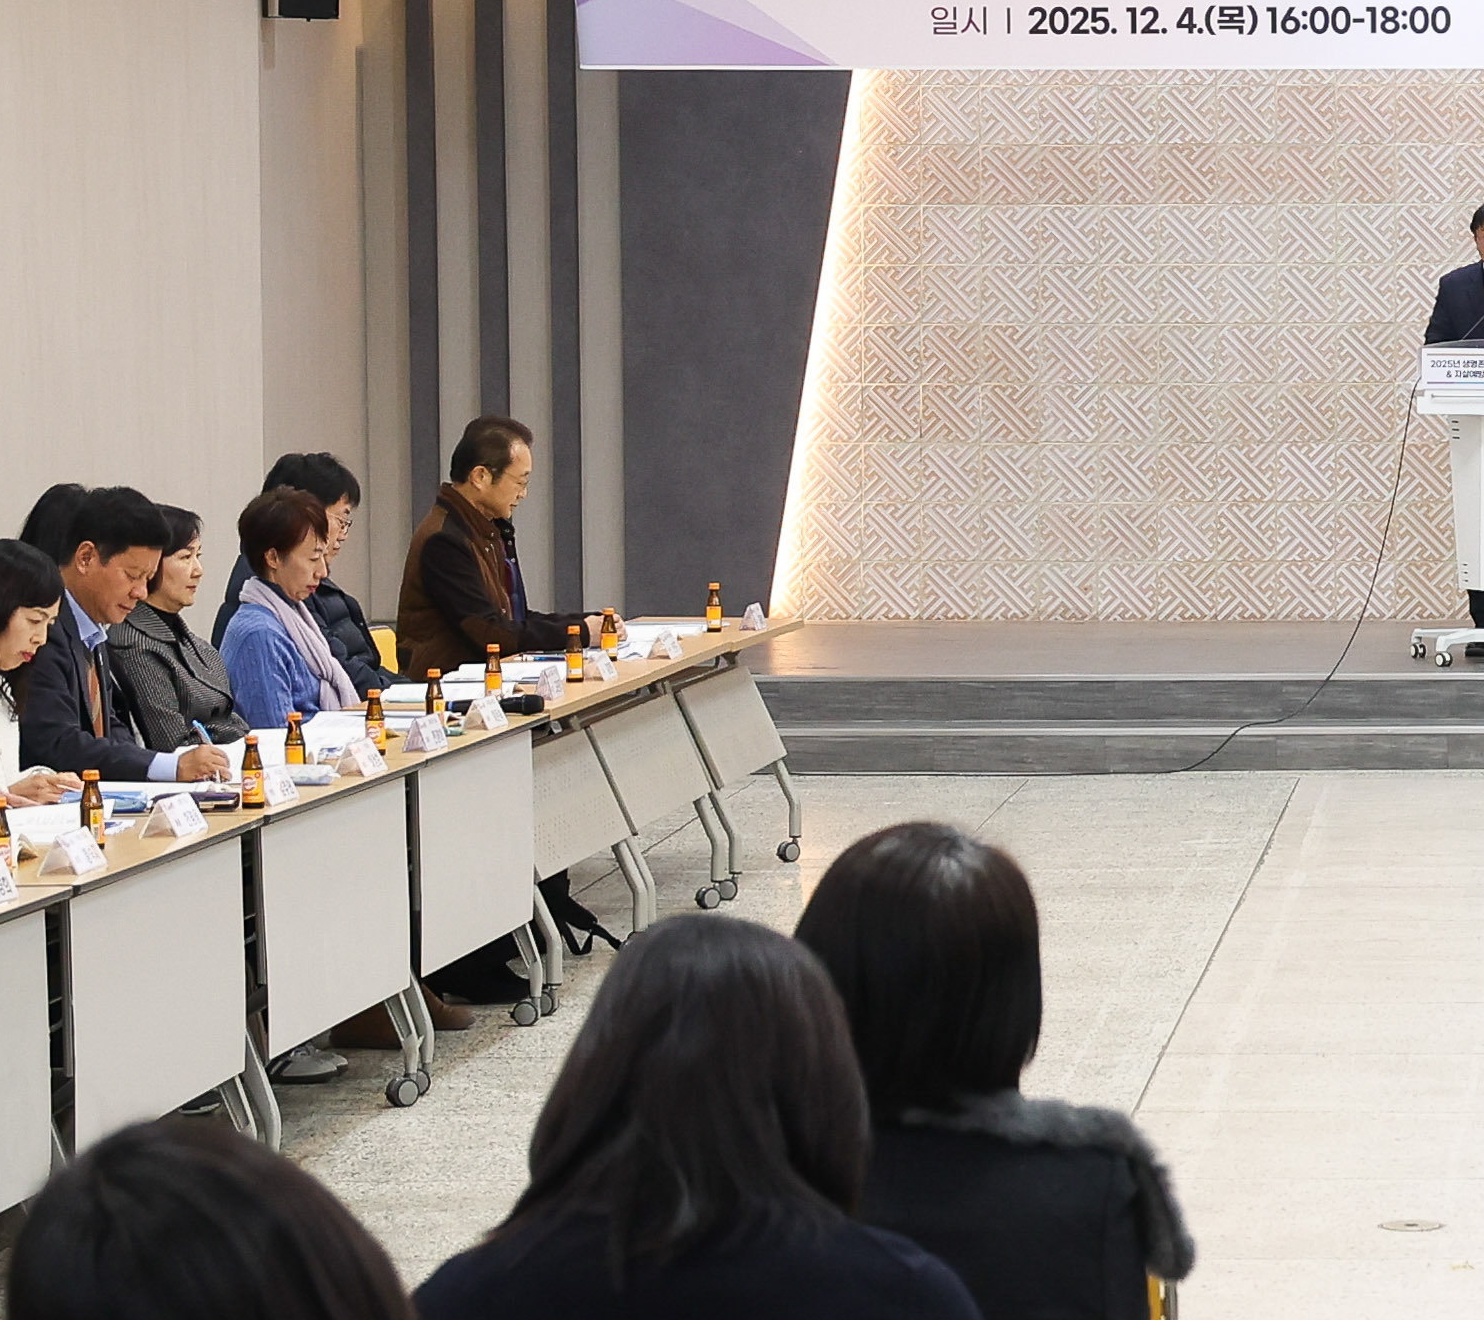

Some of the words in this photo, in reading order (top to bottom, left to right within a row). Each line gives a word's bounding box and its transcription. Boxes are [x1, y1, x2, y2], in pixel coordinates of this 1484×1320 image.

[931, 6, 989, 36] 일시
[1028, 7, 1117, 35] 2025.
[1128, 7, 1167, 35] 12.
[1177, 6, 1257, 37] 4.(목)
[1266, 6, 1451, 35] 16:00-18:00
[1430, 360, 1461, 368] 2025년
